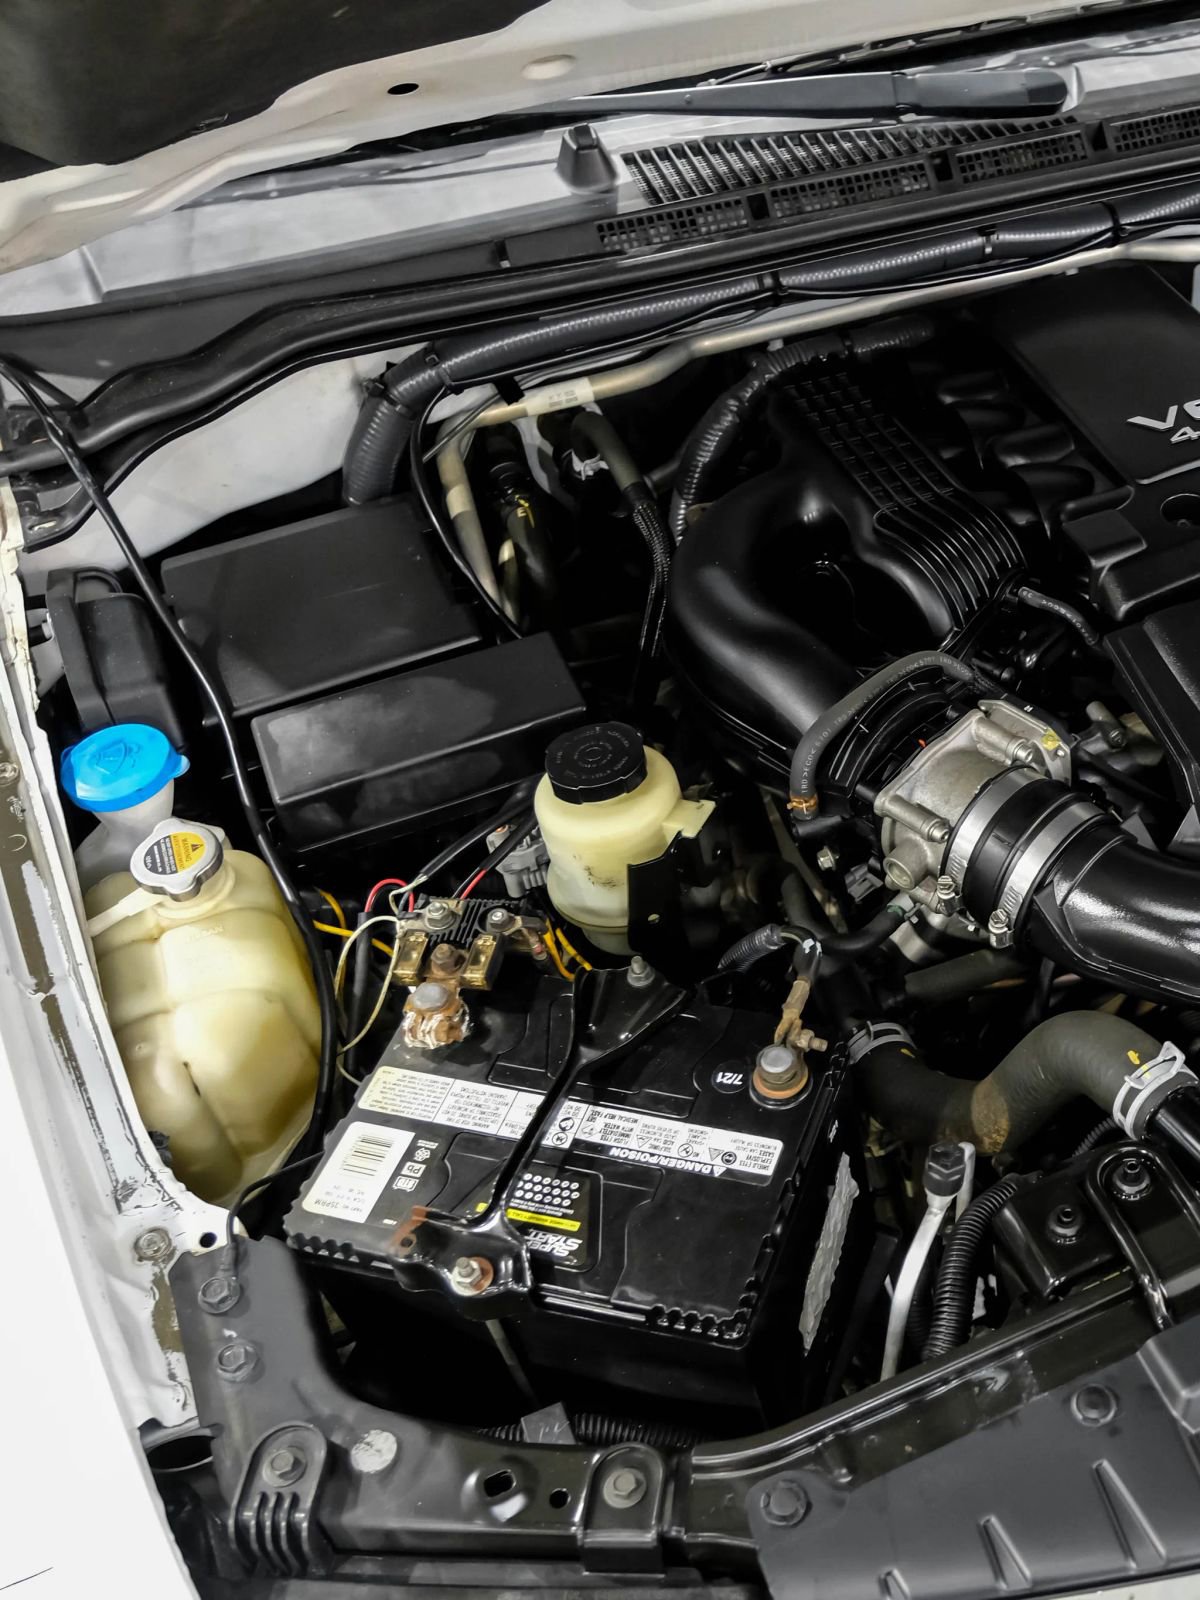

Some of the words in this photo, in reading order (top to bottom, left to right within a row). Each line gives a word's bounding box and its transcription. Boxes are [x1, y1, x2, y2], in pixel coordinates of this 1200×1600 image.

[715, 1071, 743, 1084] 7/21
[405, 1164, 421, 1173] Pb
[609, 1146, 713, 1173] DANGER/POISON
[523, 1228, 582, 1251] START
